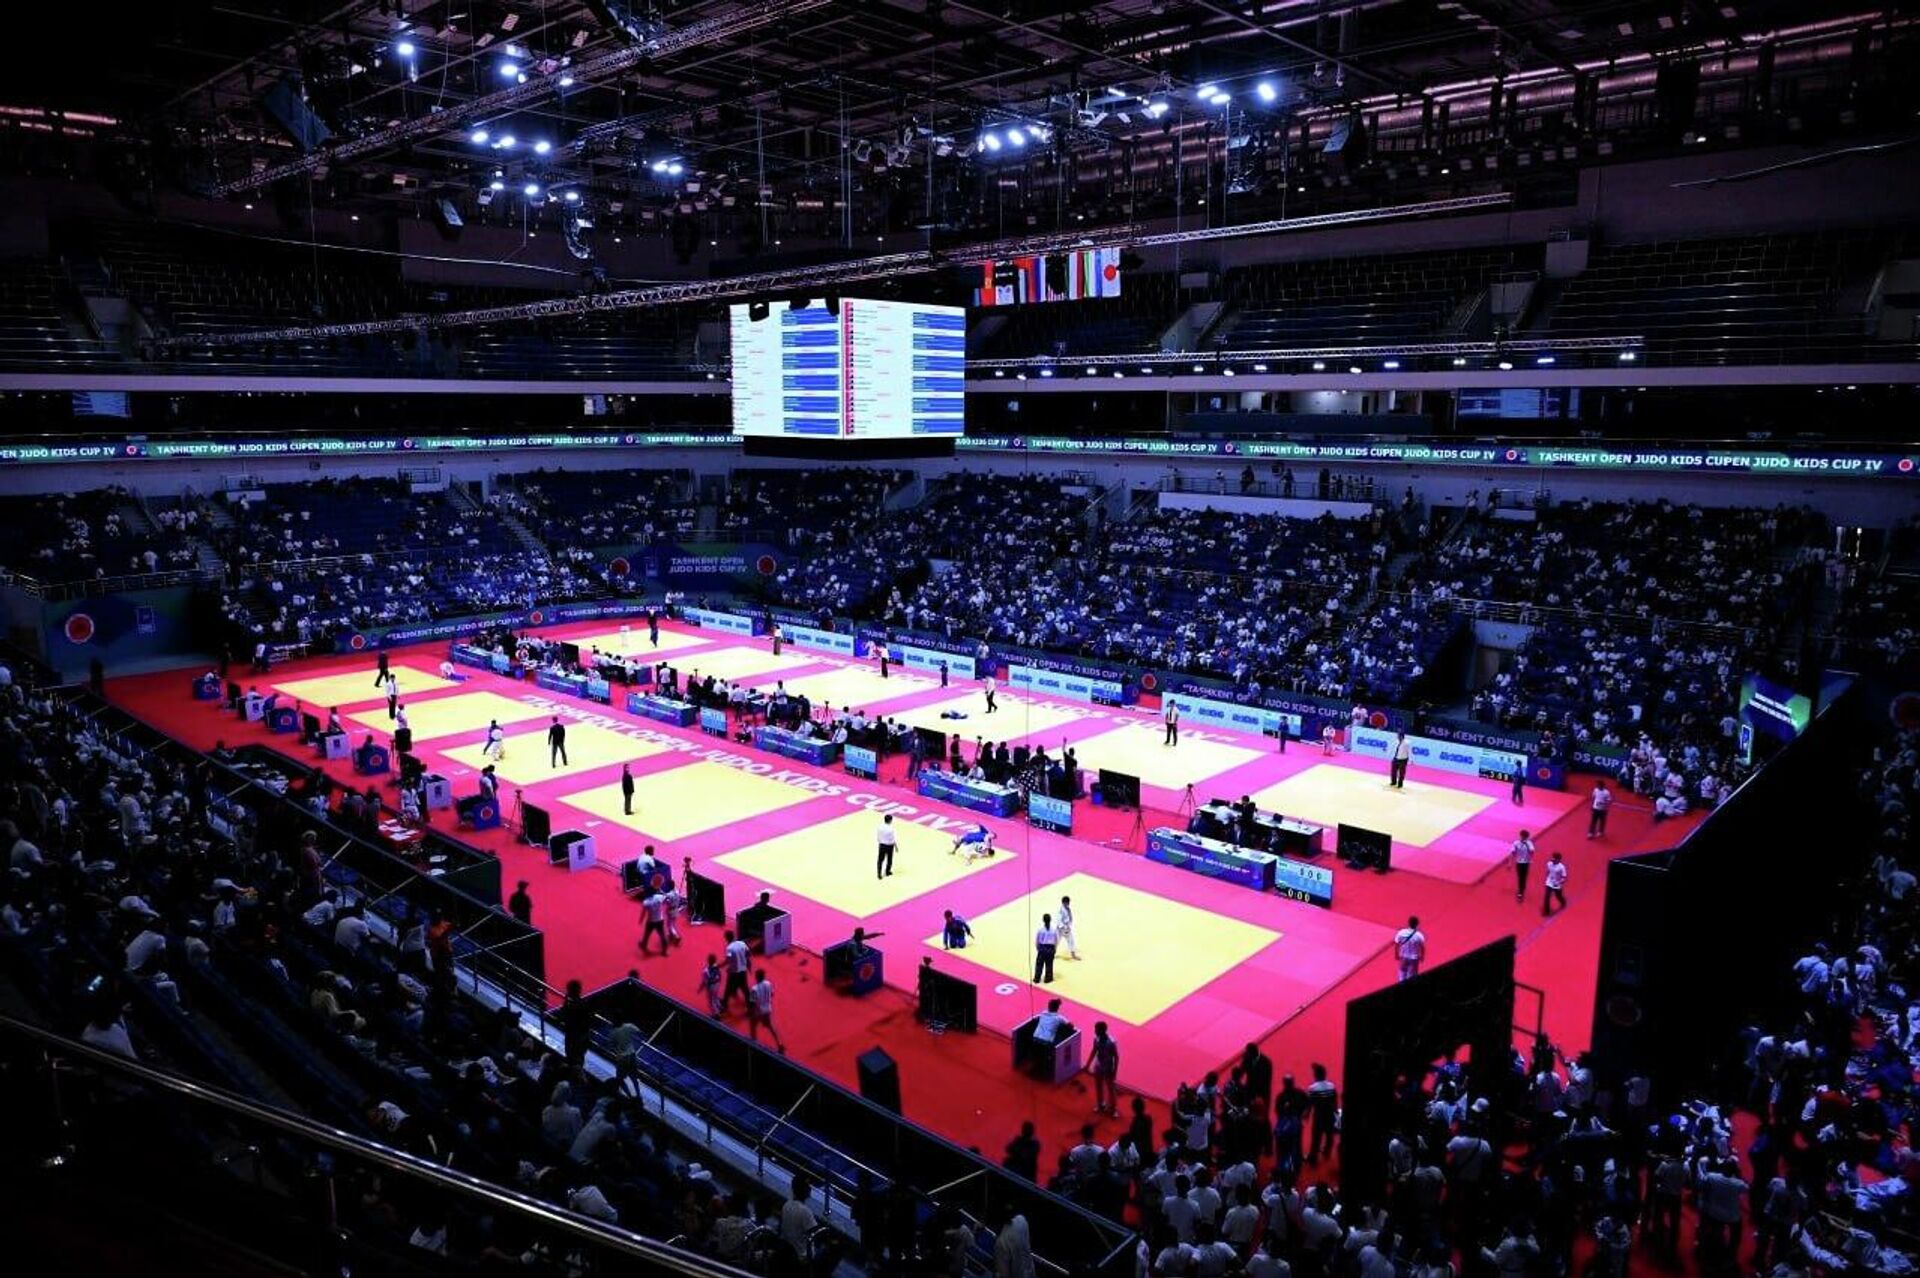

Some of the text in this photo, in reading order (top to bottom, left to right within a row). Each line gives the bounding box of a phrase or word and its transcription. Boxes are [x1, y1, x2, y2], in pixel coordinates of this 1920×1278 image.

[157, 445, 208, 455] TASHKENT
[212, 444, 236, 453] OPEN
[238, 444, 263, 452] JUDO
[265, 443, 287, 451] KIDS
[321, 442, 344, 450] JUDO
[346, 441, 366, 449] KIDS
[386, 440, 396, 448] IV
[427, 439, 465, 447] TASHKENT
[467, 439, 487, 447] OPEN
[488, 438, 507, 446] JUDO
[1065, 440, 1084, 448] OPEN
[1085, 441, 1104, 449] JUDO
[1105, 441, 1122, 449] KIDS
[1149, 442, 1169, 450] JUDO
[1171, 443, 1189, 451] KIDS
[0, 446, 115, 459] EN JUDO KIDS CUP IV
[1249, 445, 1495, 460] TASHKENT OPEN JUDO KIDS CUPEN JUDO KIDS CUP IV
[1538, 452, 1883, 470] TASHKENT OPEN JUDO KIDS CUPEN JUDO KIDS CUP IV
[671, 557, 719, 566] TASHKENT
[668, 565, 693, 574] JUDO
[1039, 659, 1060, 670] OPEN
[1101, 668, 1118, 677] CUP
[1264, 699, 1290, 710] JUDO
[1292, 703, 1316, 714] KIDS
[1318, 707, 1338, 717] CUP
[1486, 735, 1520, 749] OPEN
[1593, 755, 1620, 768] CUP
[690, 750, 774, 776] JUDO
[768, 769, 851, 796] KIDS
[846, 793, 919, 815] CUP
[994, 982, 1020, 996] 6
